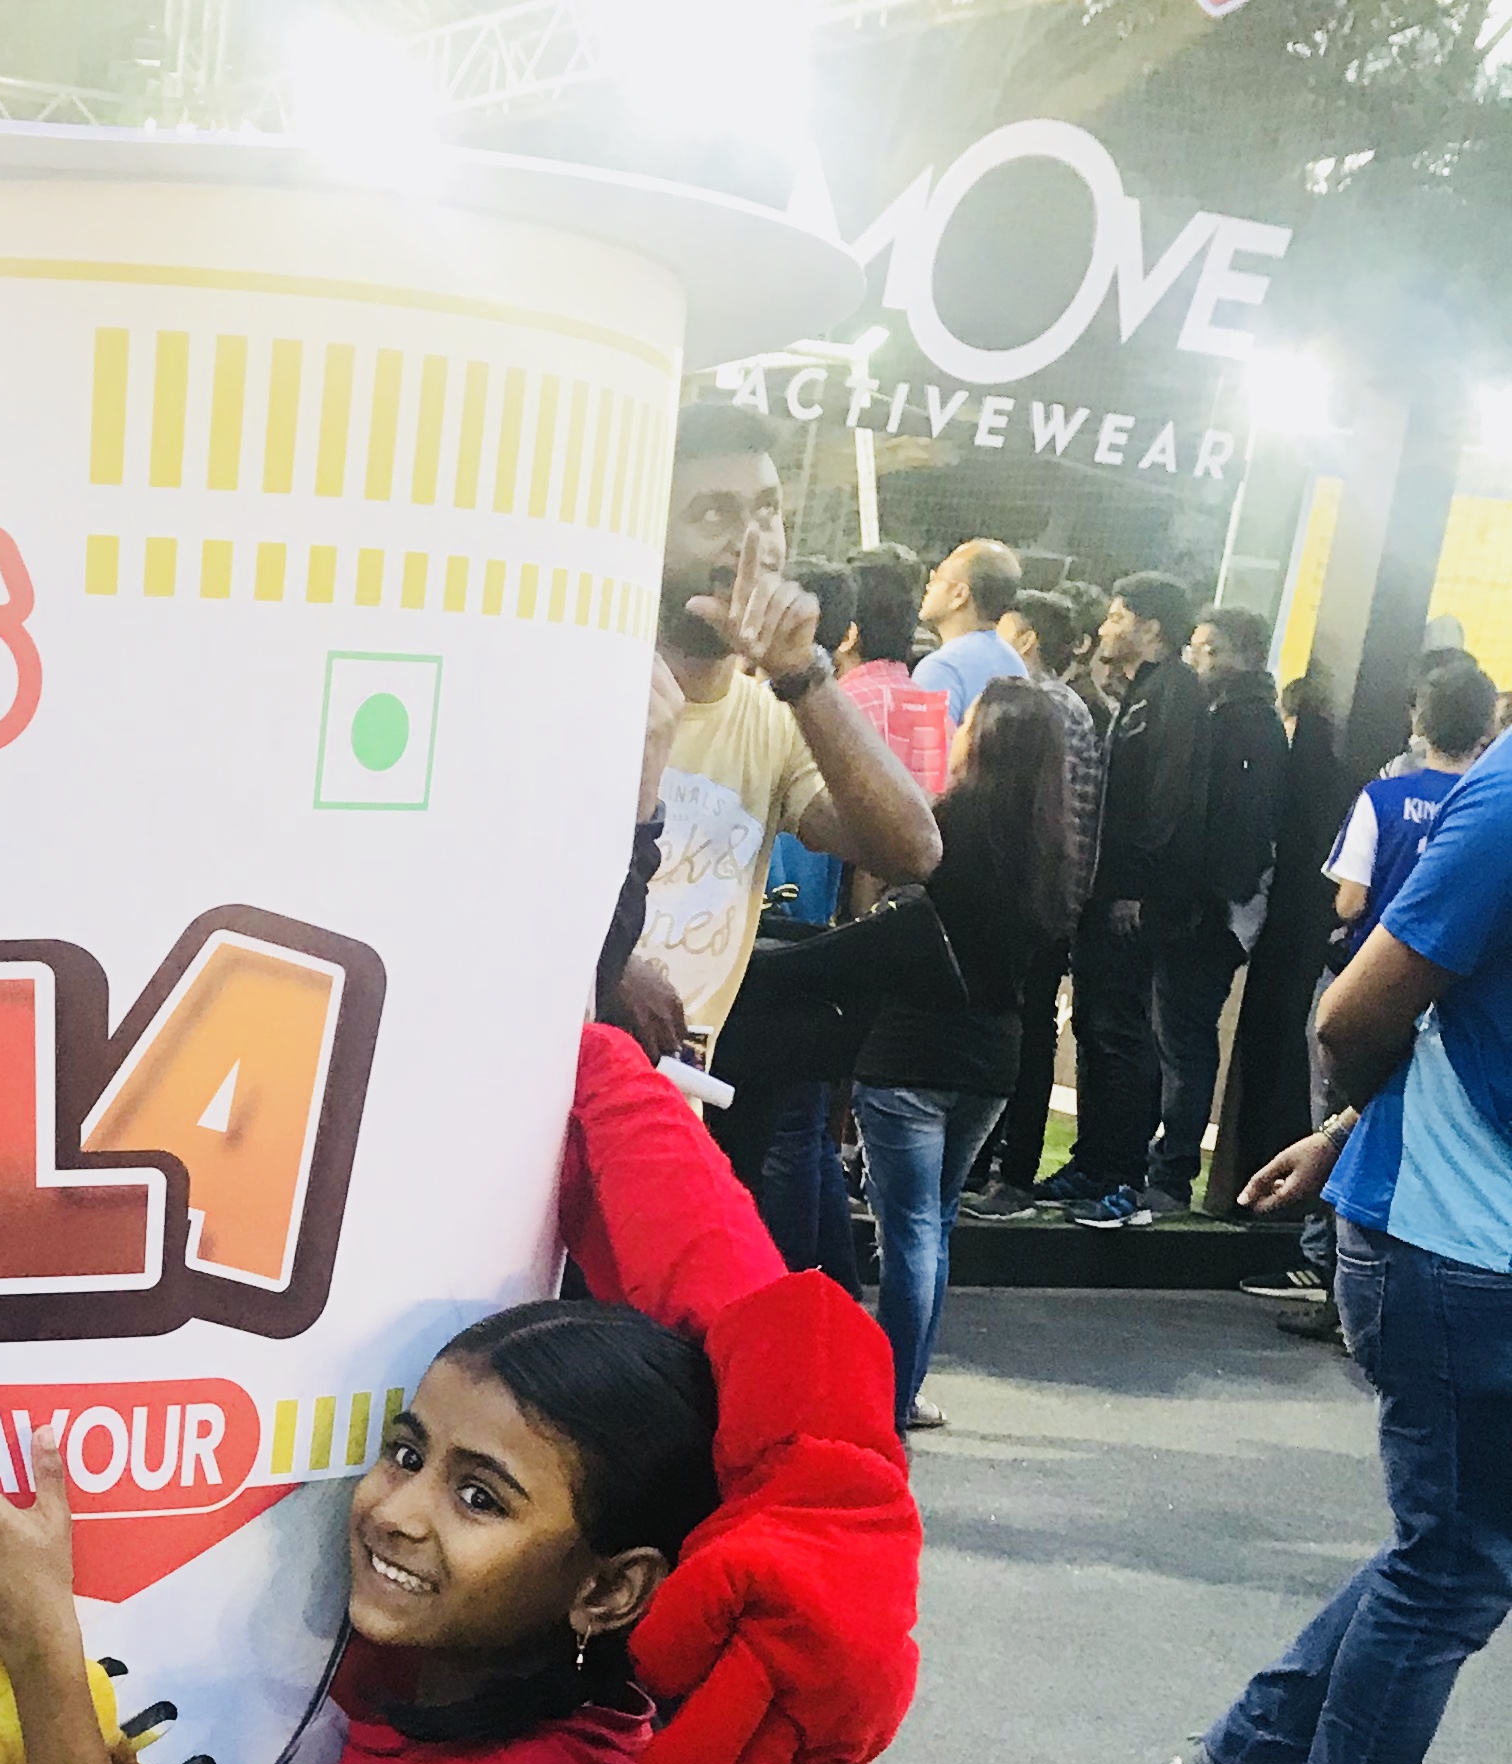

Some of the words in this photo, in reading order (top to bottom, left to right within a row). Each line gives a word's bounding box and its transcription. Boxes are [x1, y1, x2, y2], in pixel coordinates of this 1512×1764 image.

[784, 118, 1293, 385] MOVE
[731, 361, 1236, 481] ACTIVEWEAR
[1403, 797, 1442, 823] KIN
